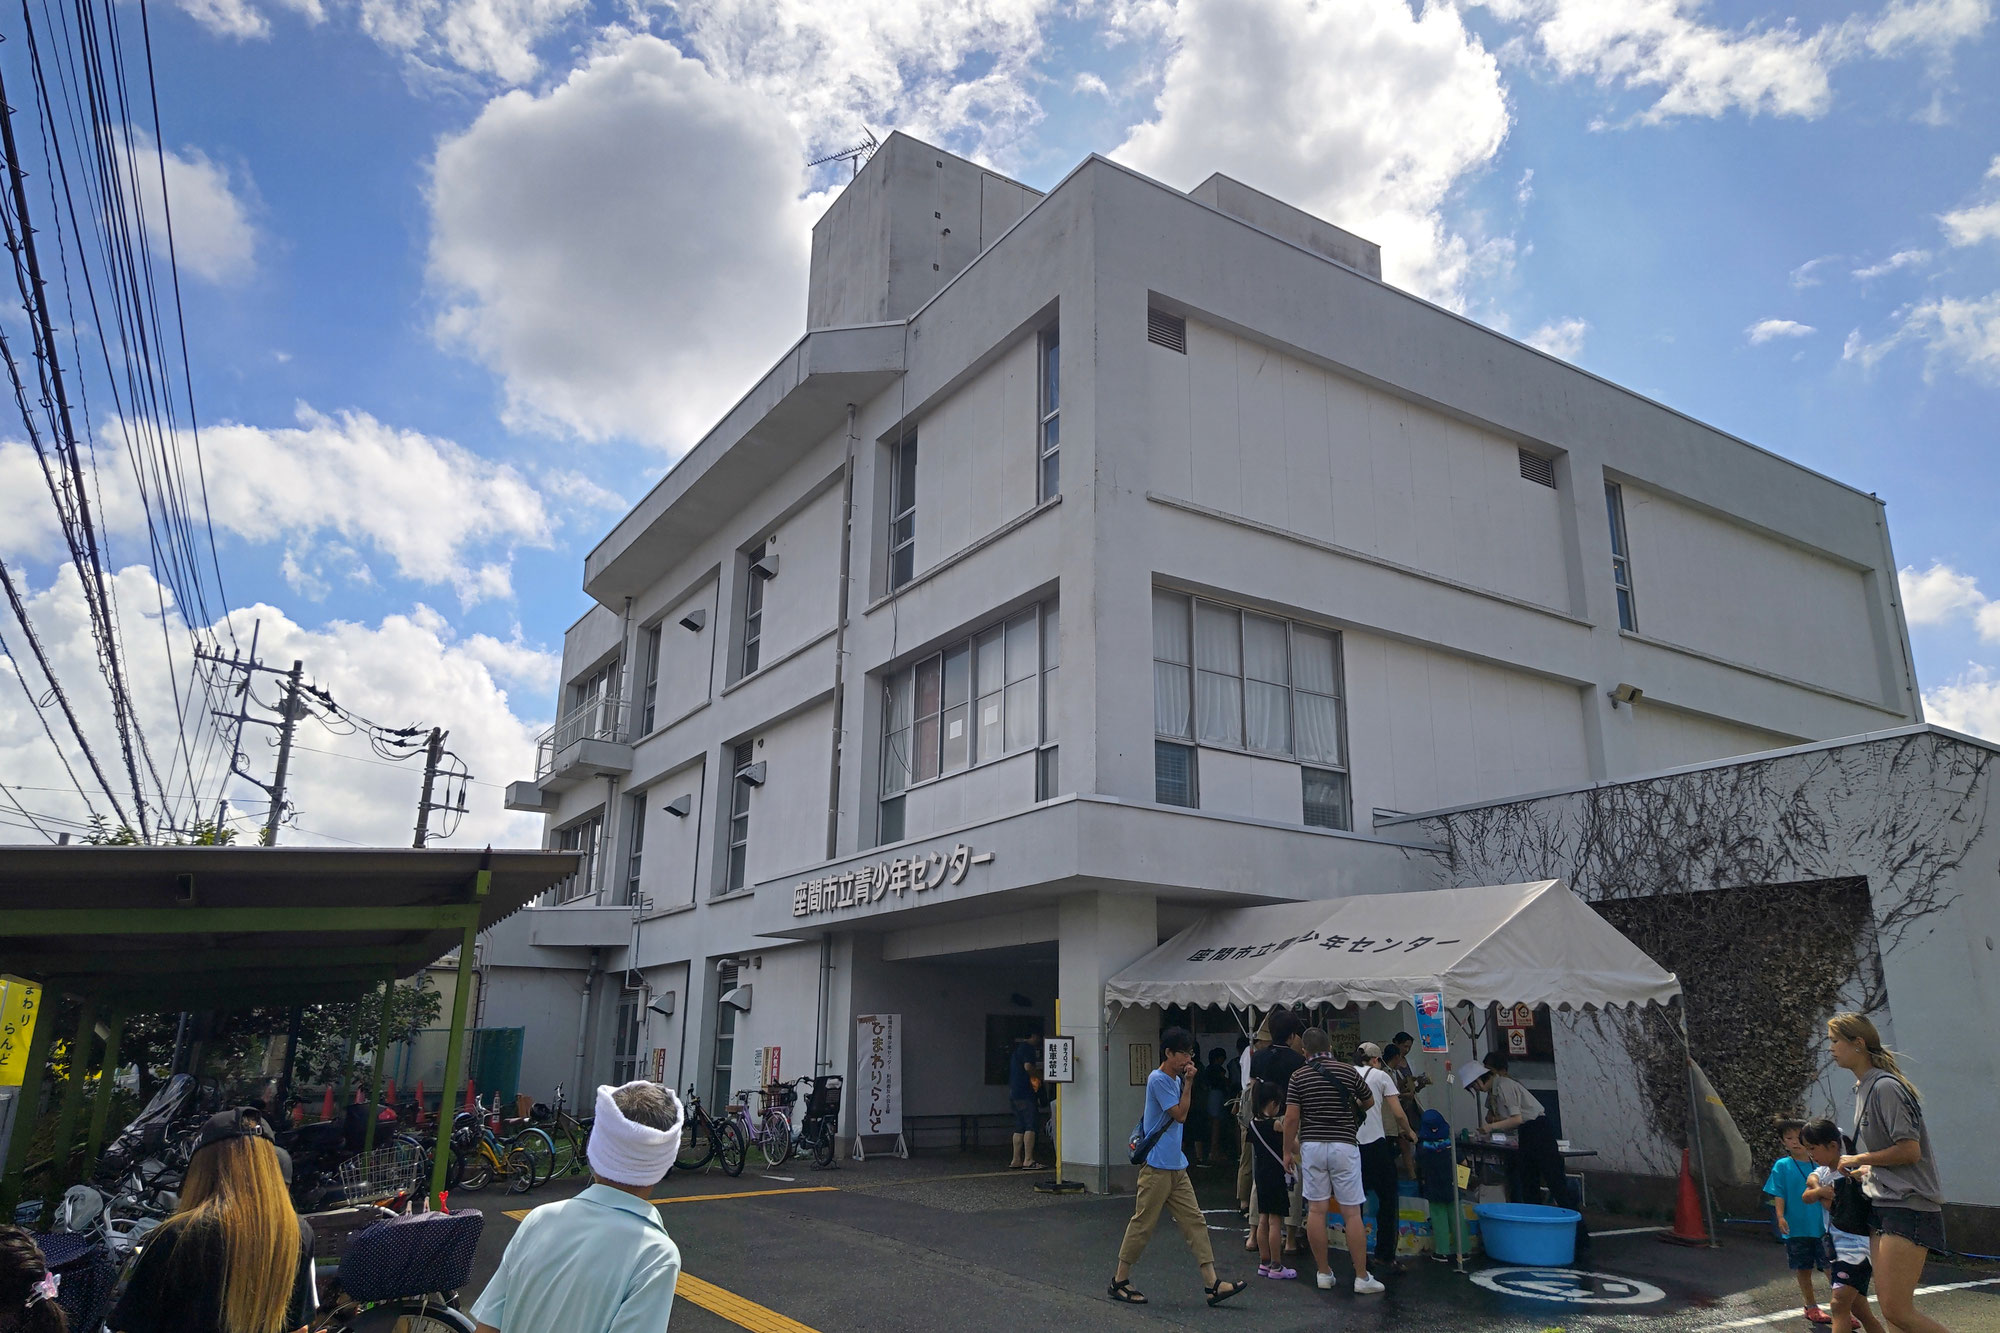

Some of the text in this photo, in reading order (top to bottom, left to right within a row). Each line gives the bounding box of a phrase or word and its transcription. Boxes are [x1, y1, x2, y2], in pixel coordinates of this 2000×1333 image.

[793, 843, 996, 917] 座間市立青少年センター
[869, 1021, 885, 1133] ひまわりらんど
[1049, 1044, 1057, 1077] 駐車禁止
